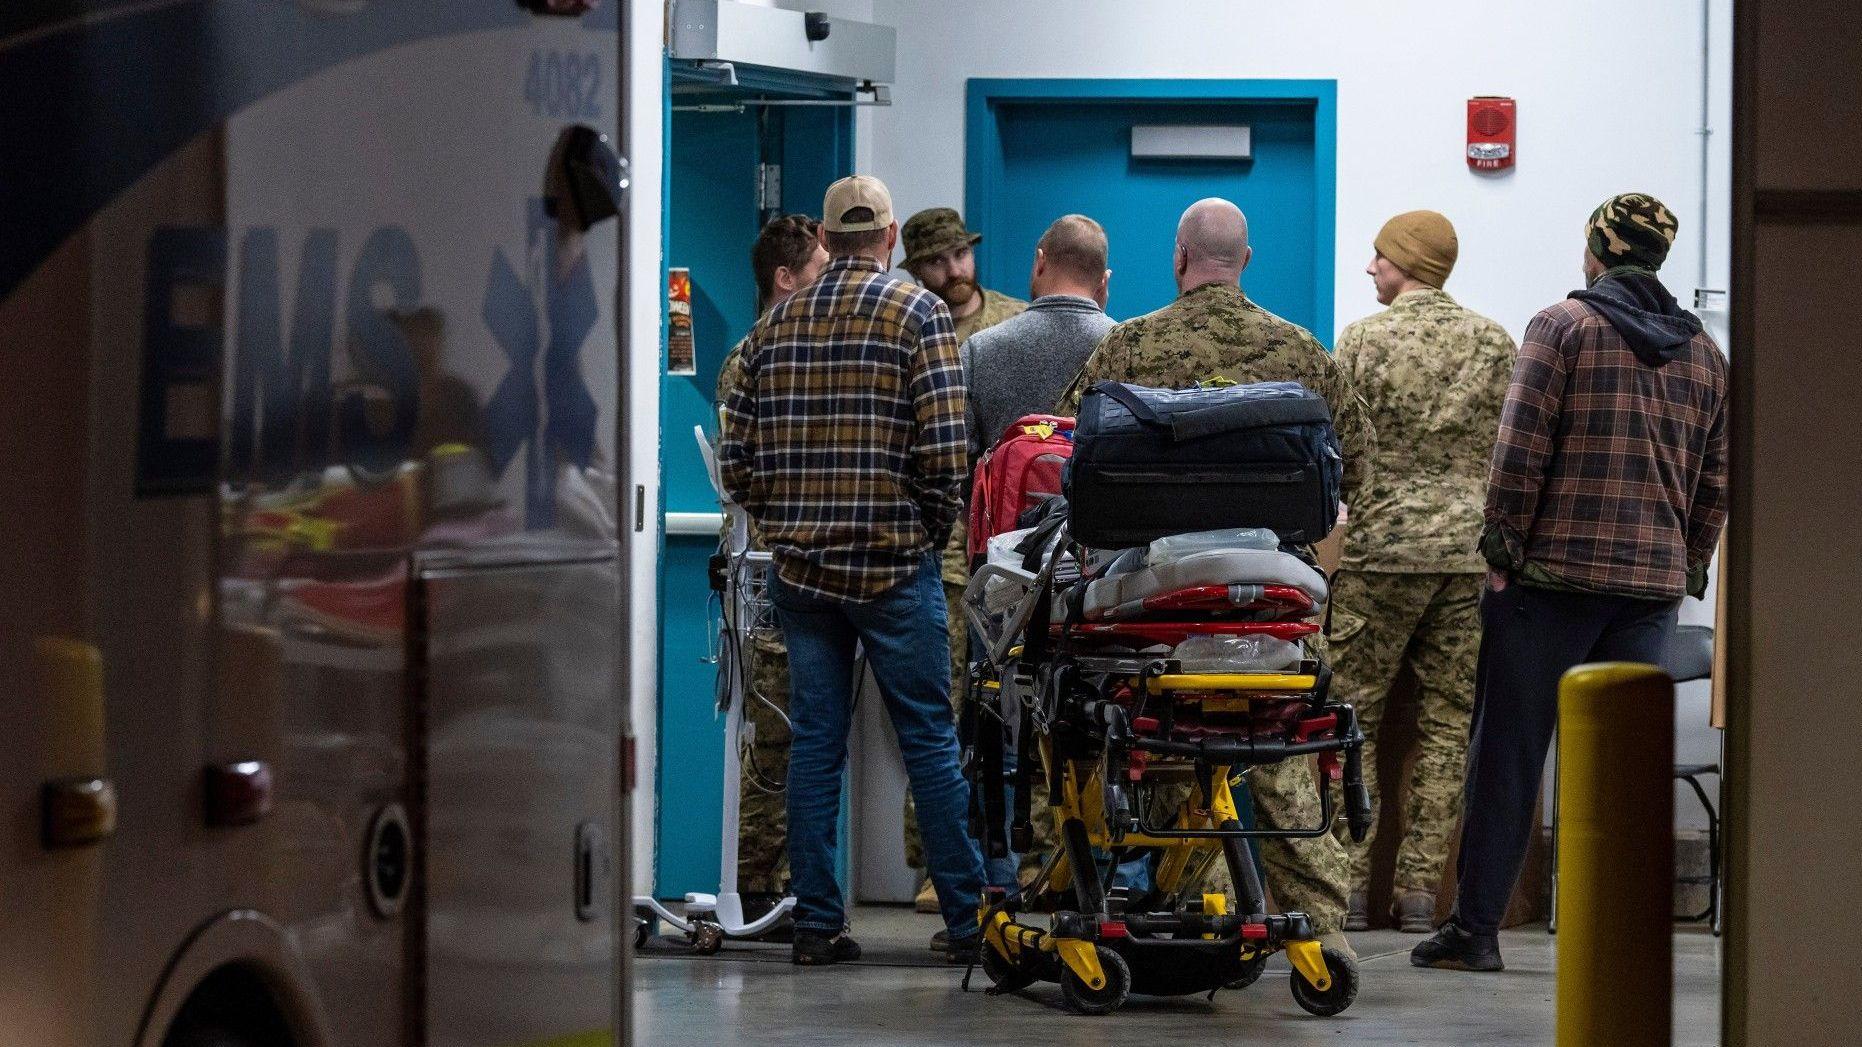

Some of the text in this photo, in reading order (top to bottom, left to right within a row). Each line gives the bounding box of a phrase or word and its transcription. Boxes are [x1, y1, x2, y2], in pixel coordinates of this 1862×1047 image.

[526, 49, 601, 118] 4082
[1476, 159, 1499, 168] FIRE
[135, 225, 423, 498] EMS
